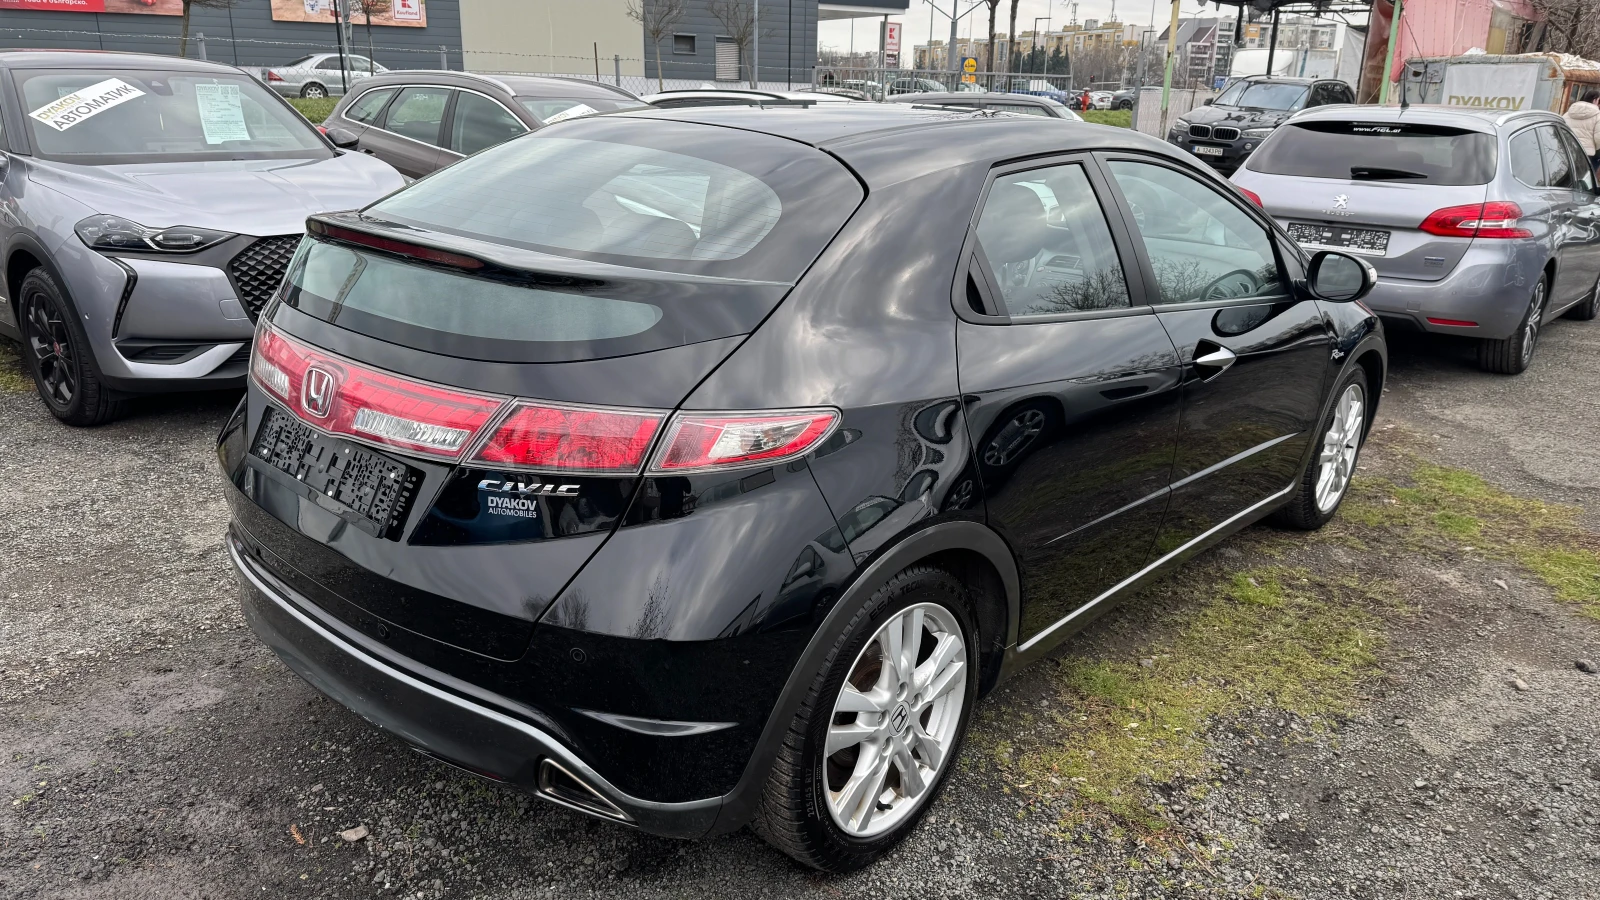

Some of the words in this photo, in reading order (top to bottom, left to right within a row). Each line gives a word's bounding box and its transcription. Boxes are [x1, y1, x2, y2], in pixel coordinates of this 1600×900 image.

[37, 94, 81, 120] DYAKOV
[53, 85, 136, 129] АВТОМАТИК
[1448, 95, 1525, 111] DYAKOV
[478, 480, 580, 496] CIVIC
[488, 496, 536, 510] DYAKOV
[488, 507, 536, 518] AUTOMOBILES
